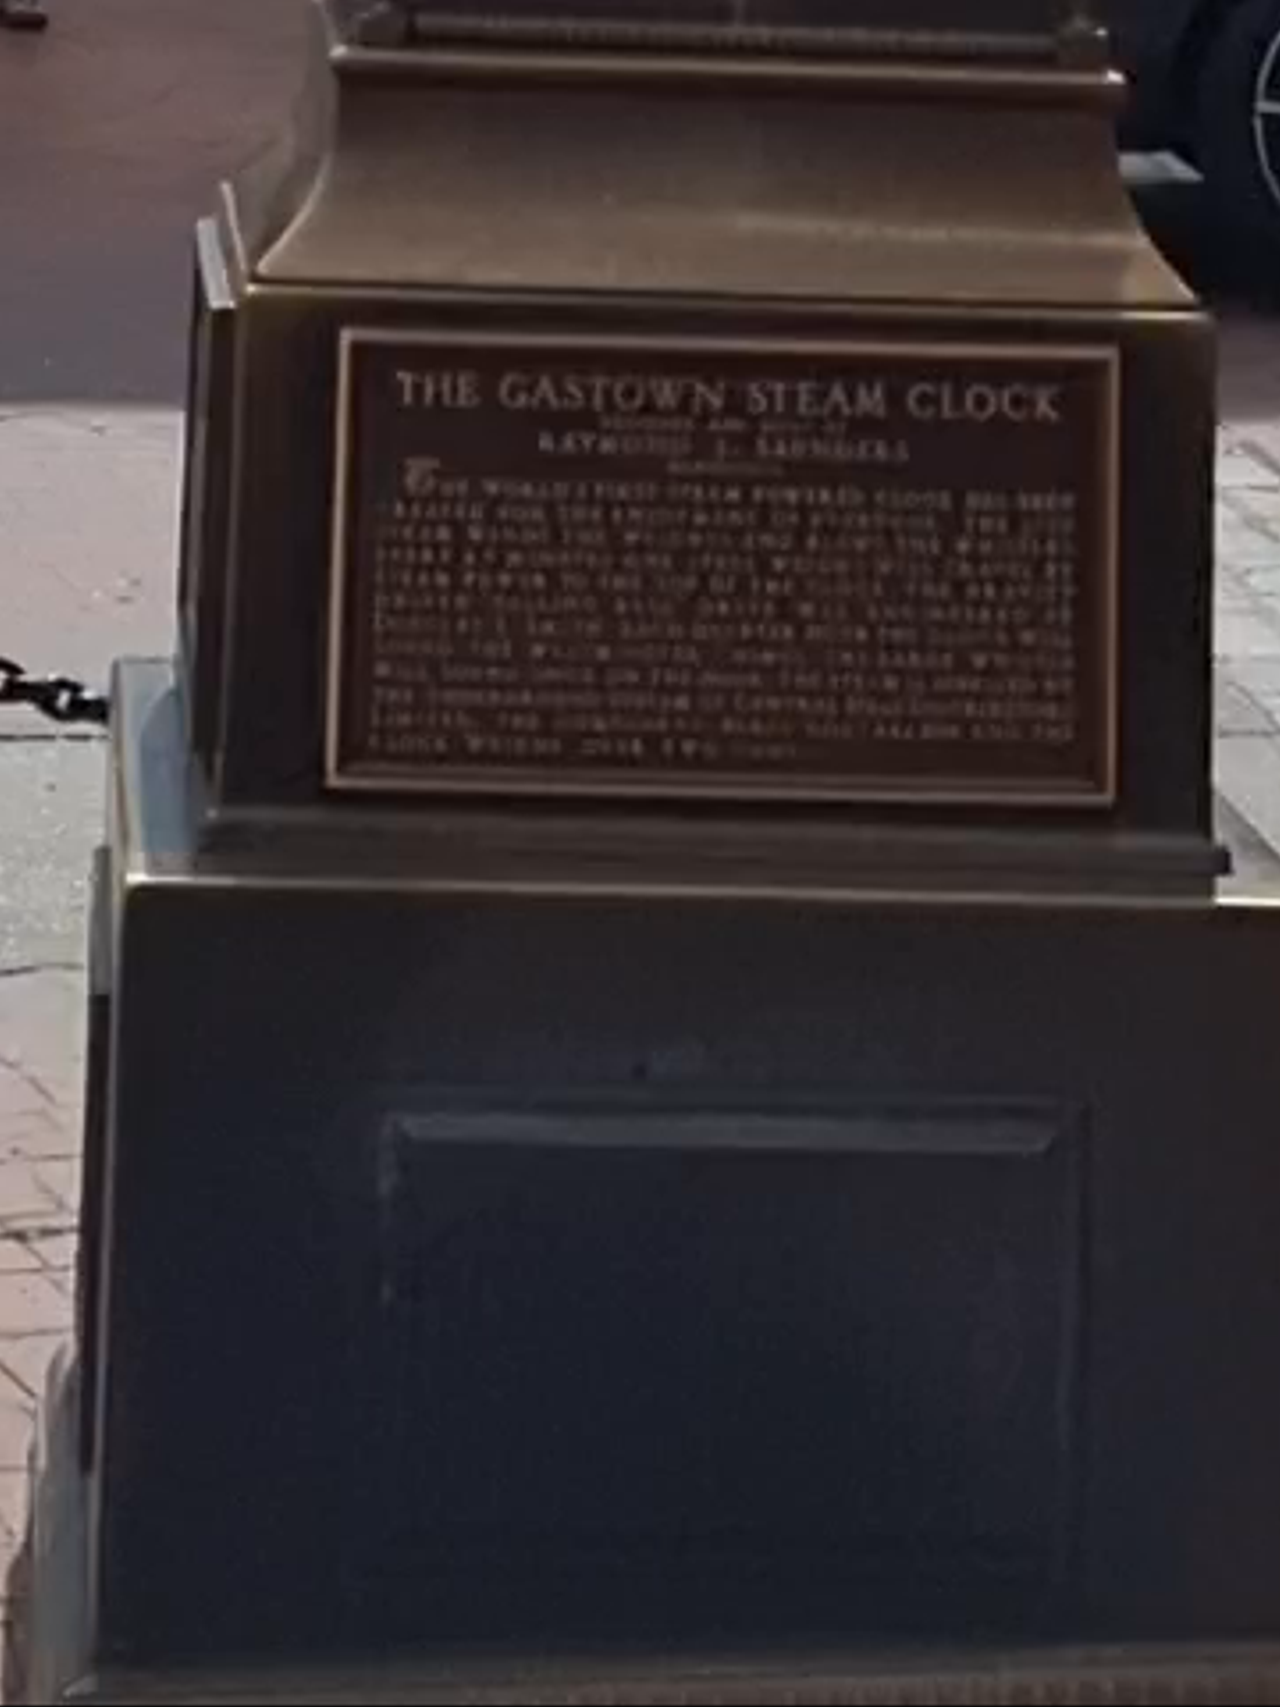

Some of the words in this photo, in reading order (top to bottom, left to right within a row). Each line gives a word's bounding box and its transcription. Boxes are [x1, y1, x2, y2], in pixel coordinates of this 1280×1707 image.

[396, 369, 482, 409] THE
[499, 372, 726, 414] GASTOWN
[745, 379, 887, 420] STEAM
[906, 382, 1061, 423] CLOCK
